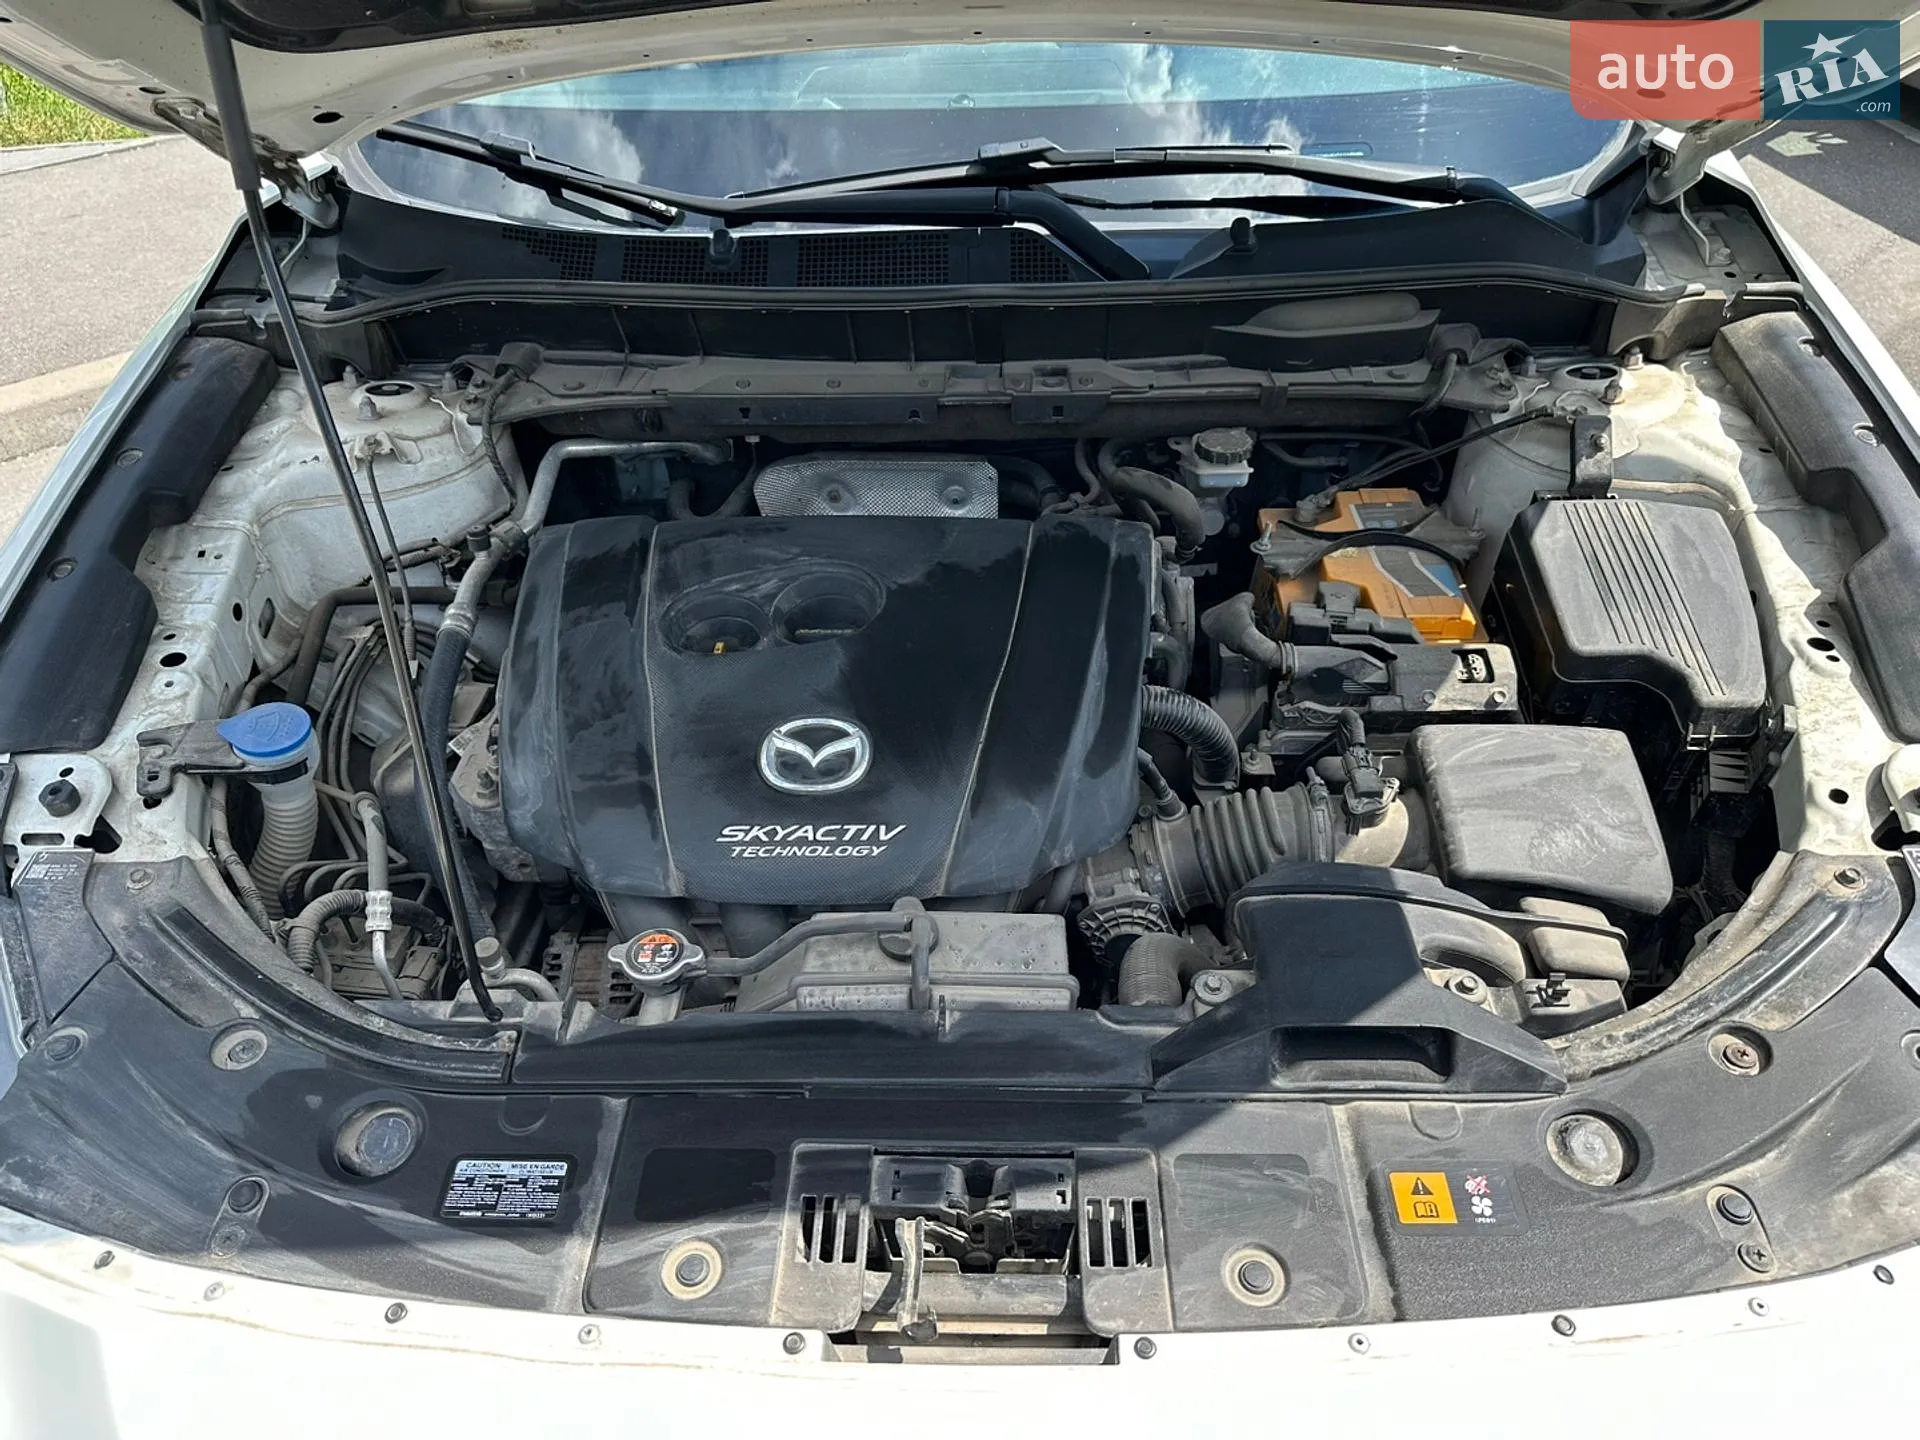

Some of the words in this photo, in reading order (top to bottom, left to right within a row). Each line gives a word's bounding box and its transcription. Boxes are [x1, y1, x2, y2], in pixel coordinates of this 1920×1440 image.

[716, 824, 907, 842] SKYACTIV
[730, 844, 888, 858] TECHNOLOGY
[540, 1163, 566, 1171] GARDE
